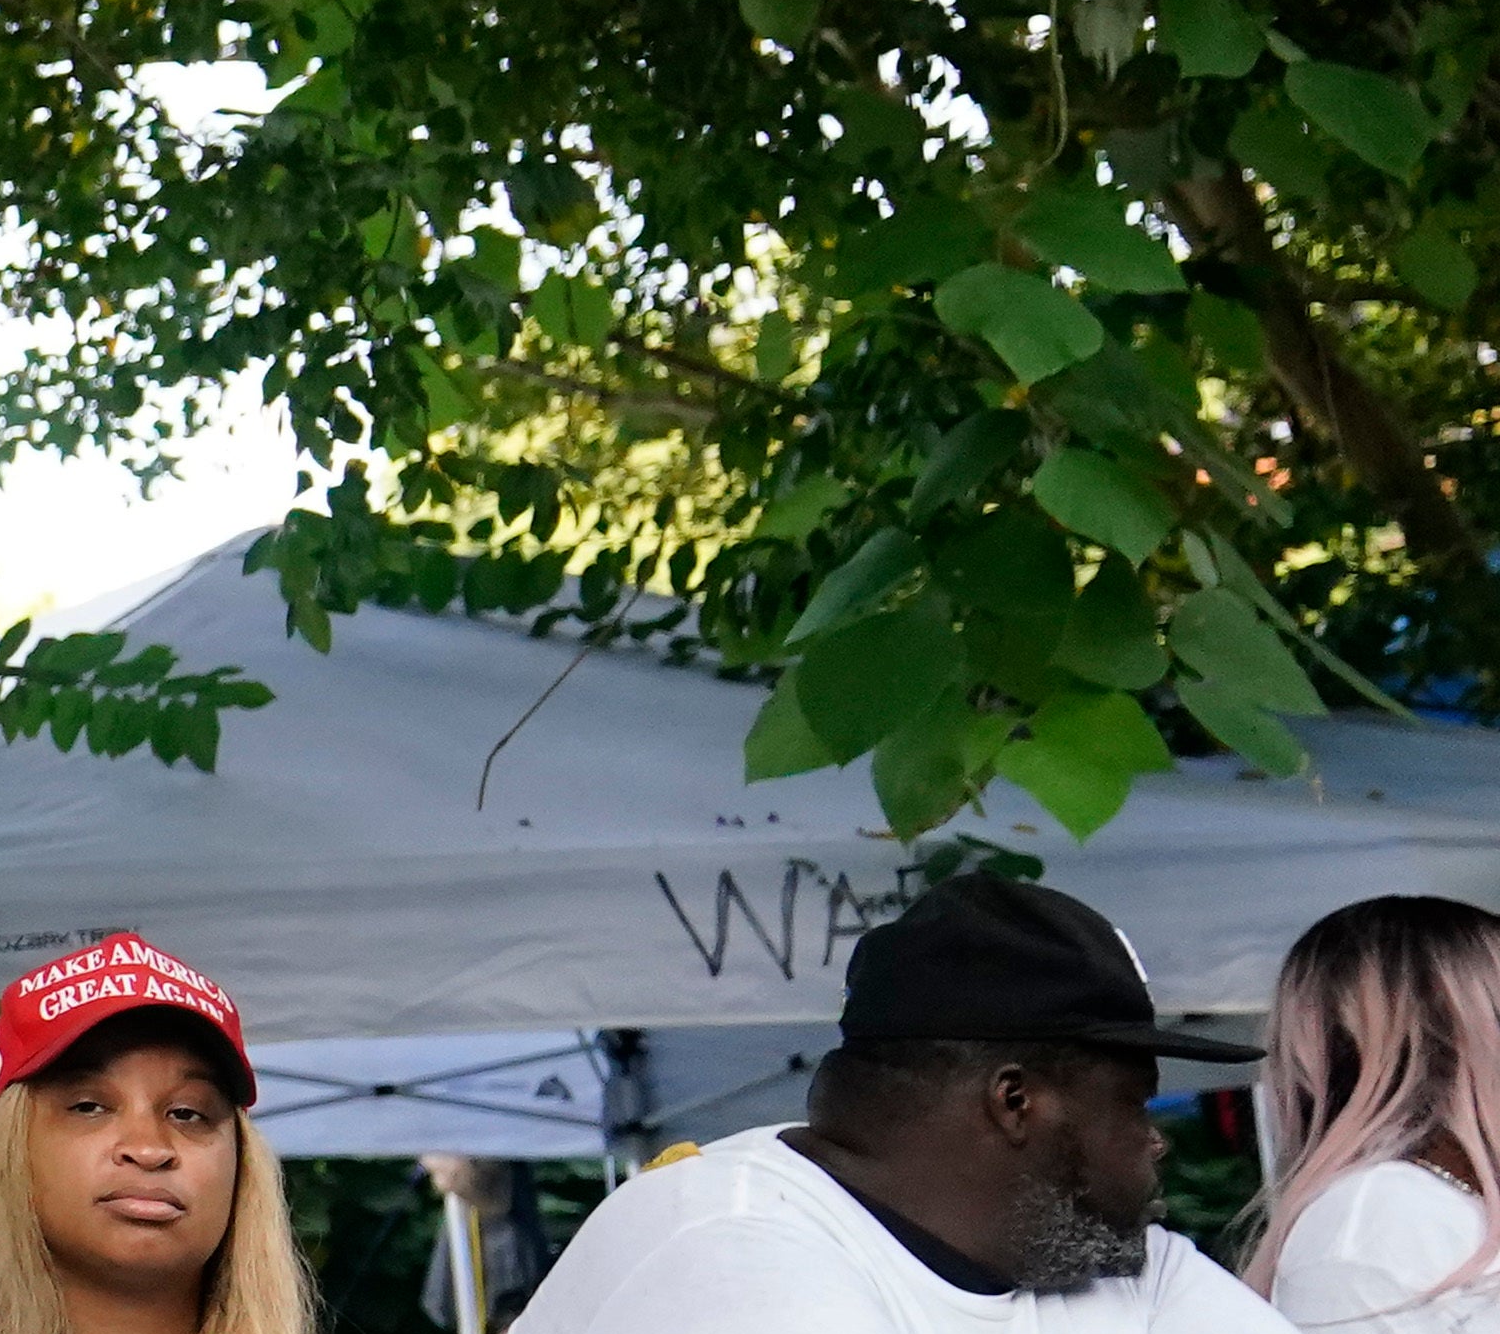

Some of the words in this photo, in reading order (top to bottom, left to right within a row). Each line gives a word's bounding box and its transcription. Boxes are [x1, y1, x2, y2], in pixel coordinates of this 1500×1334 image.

[18, 948, 106, 998] MAKE
[110, 940, 234, 1013] AMERICA
[39, 973, 137, 1021] GREAT
